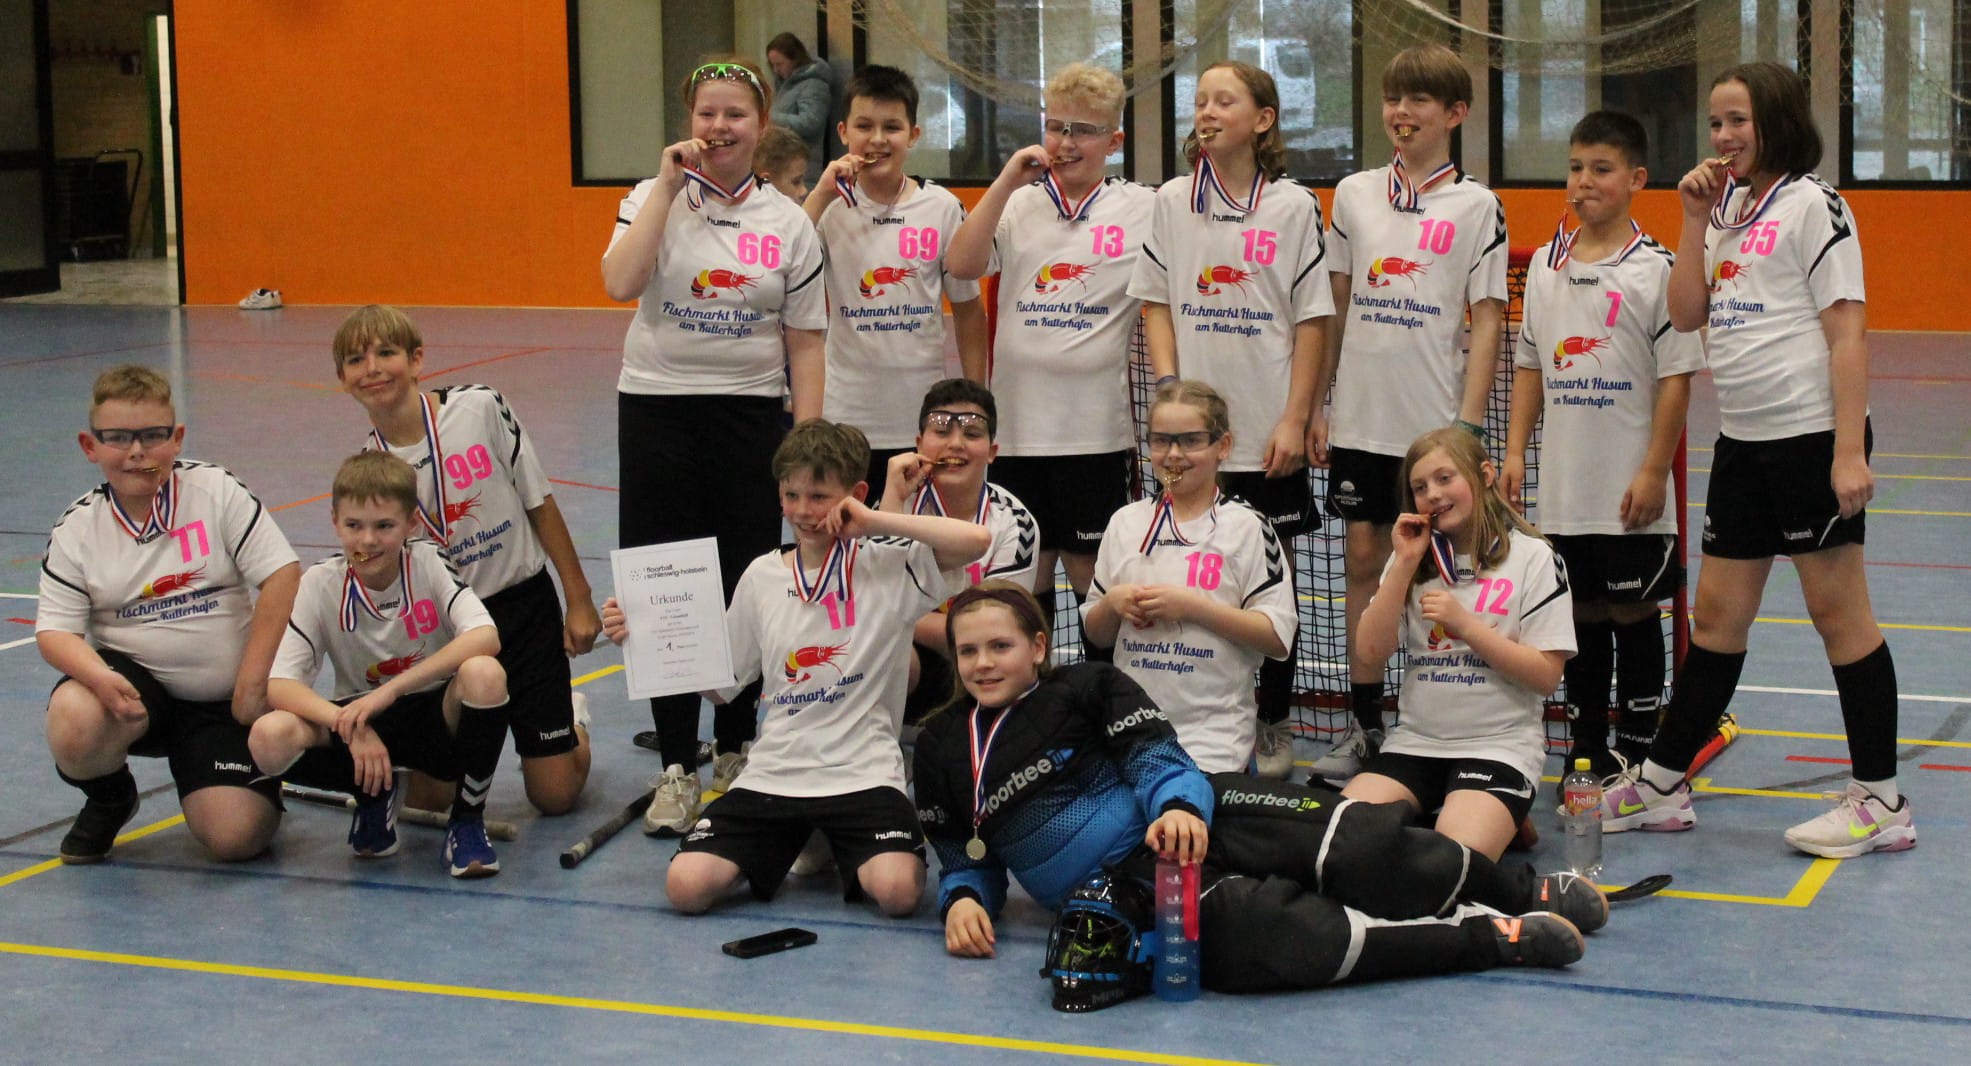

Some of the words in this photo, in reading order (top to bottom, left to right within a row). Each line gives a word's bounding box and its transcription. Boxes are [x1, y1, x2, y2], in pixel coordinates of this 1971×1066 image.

[706, 215, 741, 229] hummel
[872, 216, 905, 225] hummel
[1212, 212, 1245, 223] hummel
[898, 227, 939, 261] 69
[1089, 224, 1125, 258] 13
[1417, 218, 1456, 255] 10
[1740, 220, 1781, 256] 55
[737, 232, 781, 269] 66
[1241, 228, 1277, 266] 15
[1568, 276, 1600, 287] hummel
[663, 301, 730, 321] Fischmarkt
[902, 303, 934, 316] Husum
[1074, 301, 1109, 315] Husum
[1180, 303, 1239, 319] Fischmarkt
[1403, 297, 1441, 316] Husum
[1605, 290, 1623, 328] 7
[1727, 297, 1764, 312] Husum
[679, 320, 696, 331] am
[697, 322, 752, 338] Kutterhafen
[856, 324, 871, 332] am
[1024, 319, 1039, 327] am
[1041, 317, 1093, 331] Kutterhafen
[1195, 323, 1210, 332] am
[1211, 322, 1262, 337] Kutterhafen
[1374, 312, 1424, 330] Kutterhafen
[1591, 377, 1633, 391] Husum
[1562, 394, 1615, 409] Kutterhafen
[444, 443, 493, 490] 99
[475, 519, 512, 544] Husum
[1076, 530, 1104, 540] humm
[170, 519, 210, 564] 77
[1185, 551, 1224, 591] 18
[1607, 577, 1642, 590] hummel
[649, 591, 694, 606] Urkunde
[1474, 578, 1514, 616] 72
[160, 600, 219, 621] Kutterhafen
[397, 598, 440, 641] 19
[1173, 641, 1214, 659] Husum
[1141, 658, 1194, 675] Kutterhafen
[1462, 653, 1490, 669] Hus
[1430, 671, 1486, 686] Kutterhafen
[214, 760, 252, 773] hummel
[983, 758, 1053, 815] loorbee
[1221, 789, 1301, 809] floorbee
[1573, 794, 1598, 806] hella
[875, 830, 913, 840] hummel
